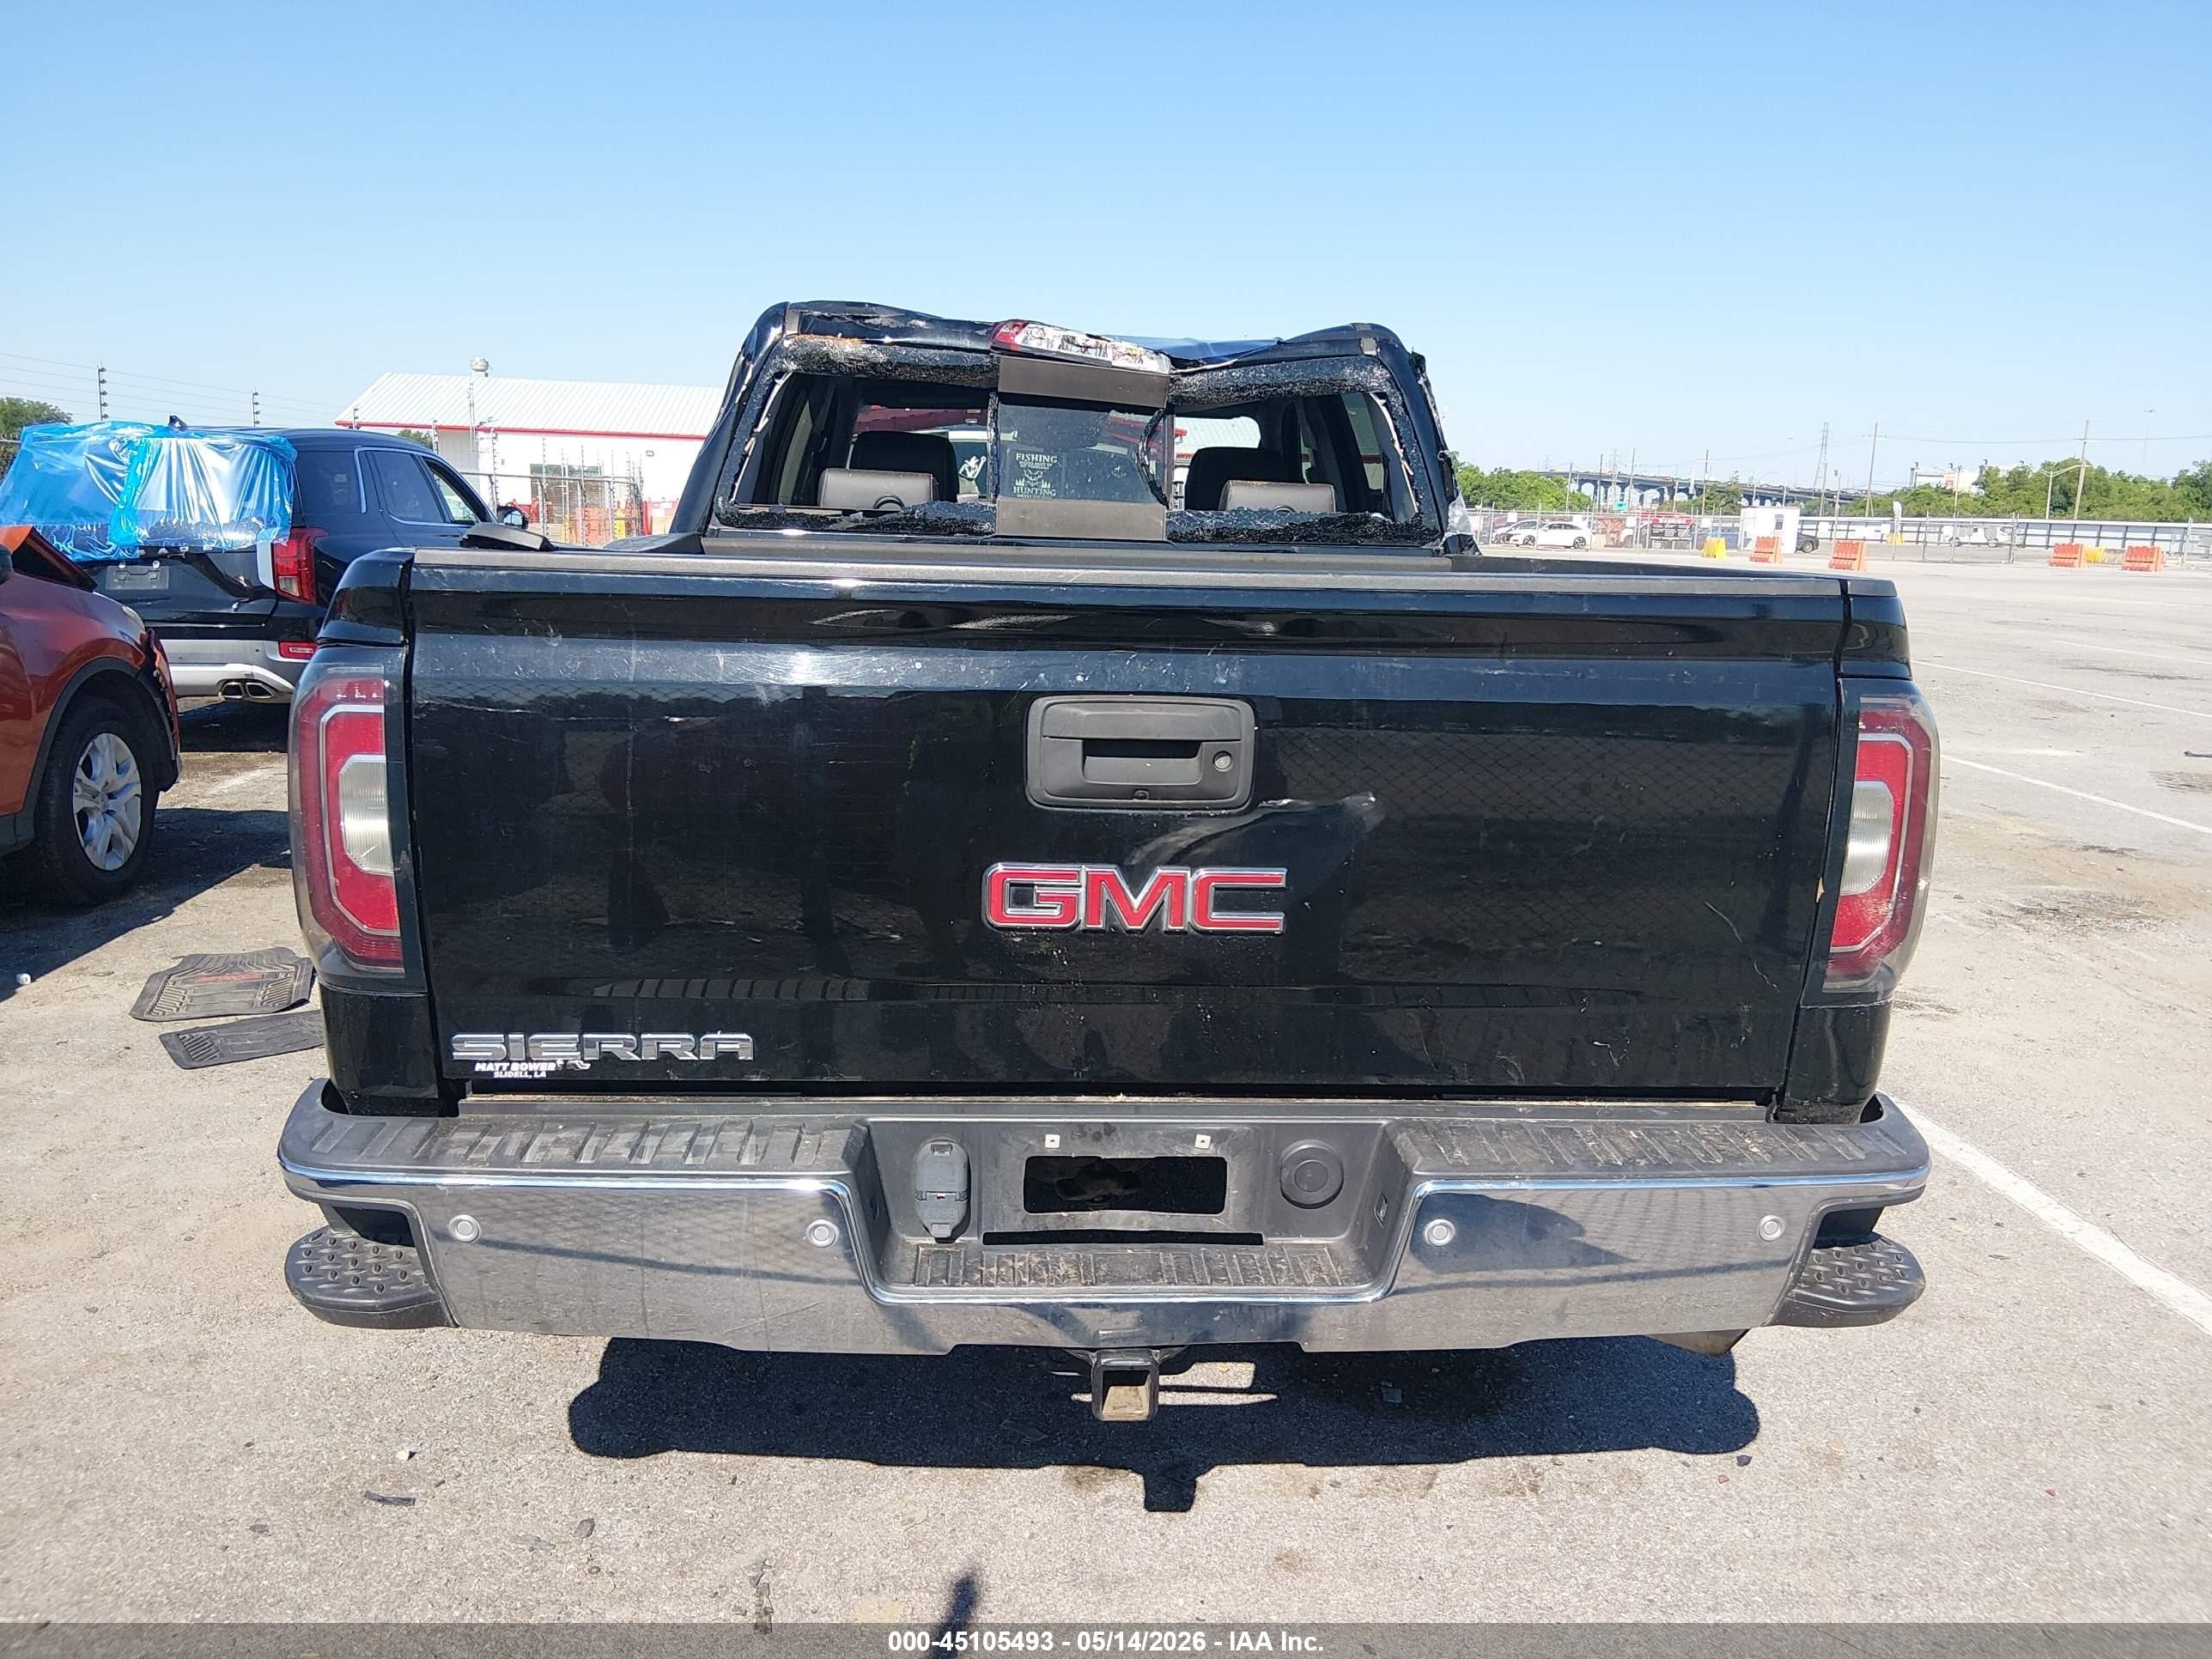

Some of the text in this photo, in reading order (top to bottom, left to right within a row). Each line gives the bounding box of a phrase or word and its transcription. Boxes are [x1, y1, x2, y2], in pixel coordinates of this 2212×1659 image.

[1016, 453, 1058, 463] FISHING
[1013, 486, 1057, 496] HUNTING
[982, 862, 1287, 935] GMC
[452, 1033, 754, 1061] SIERRA
[475, 1062, 510, 1071] MATT
